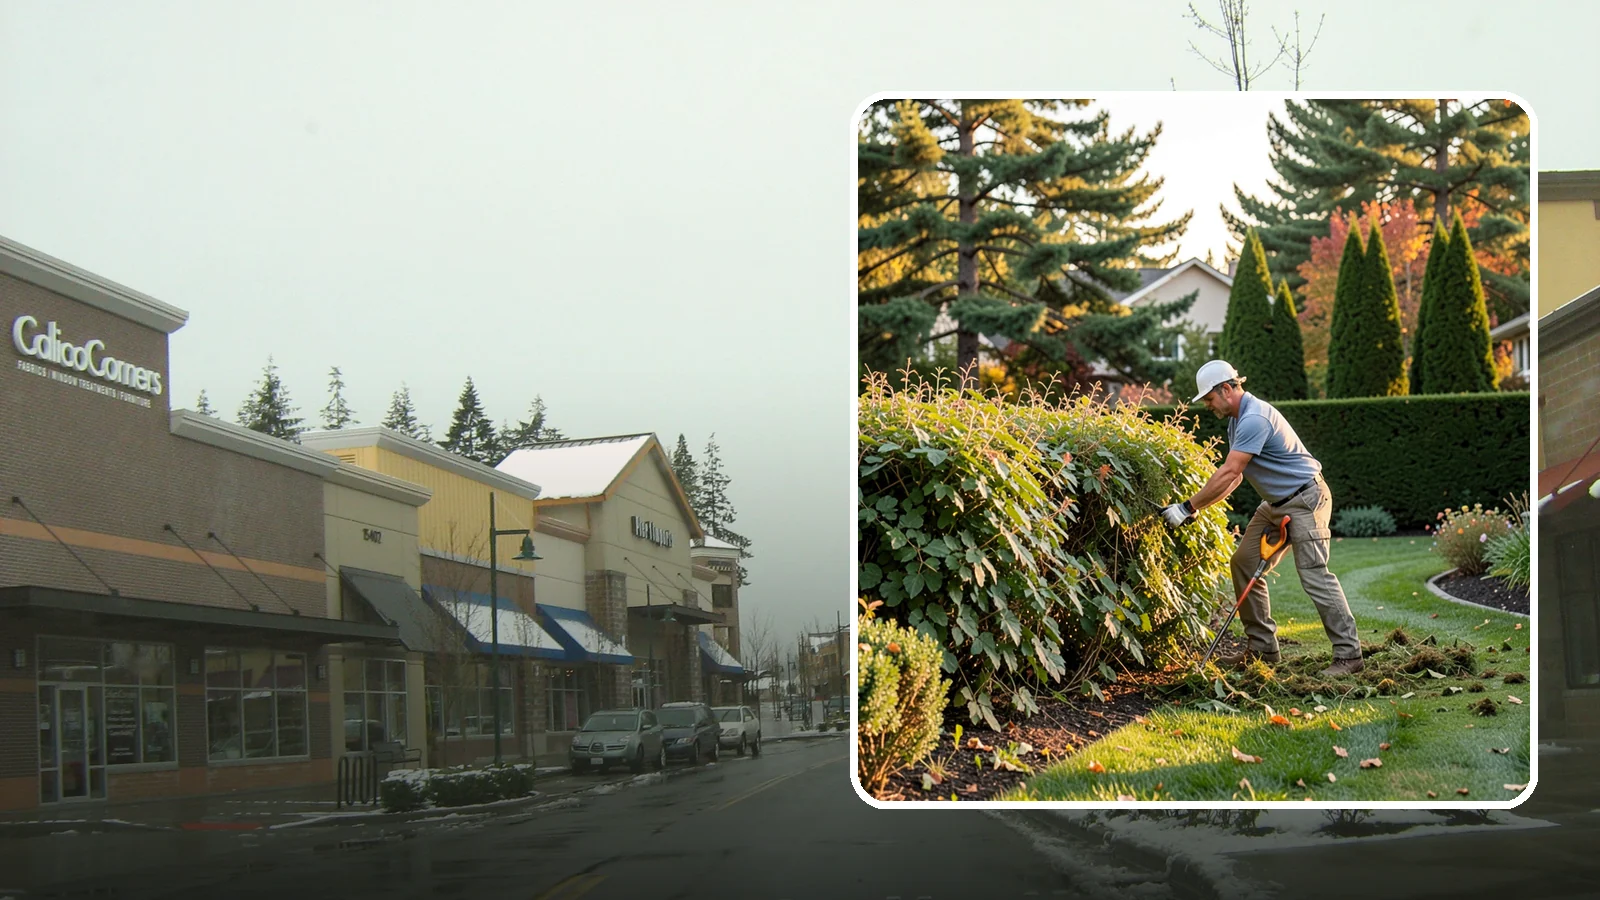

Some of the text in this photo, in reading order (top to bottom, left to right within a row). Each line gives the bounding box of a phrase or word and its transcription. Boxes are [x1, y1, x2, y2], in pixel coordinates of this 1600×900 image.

[17, 360, 151, 409] FABRICS WINDOW TREATMENTS FURNITURE
